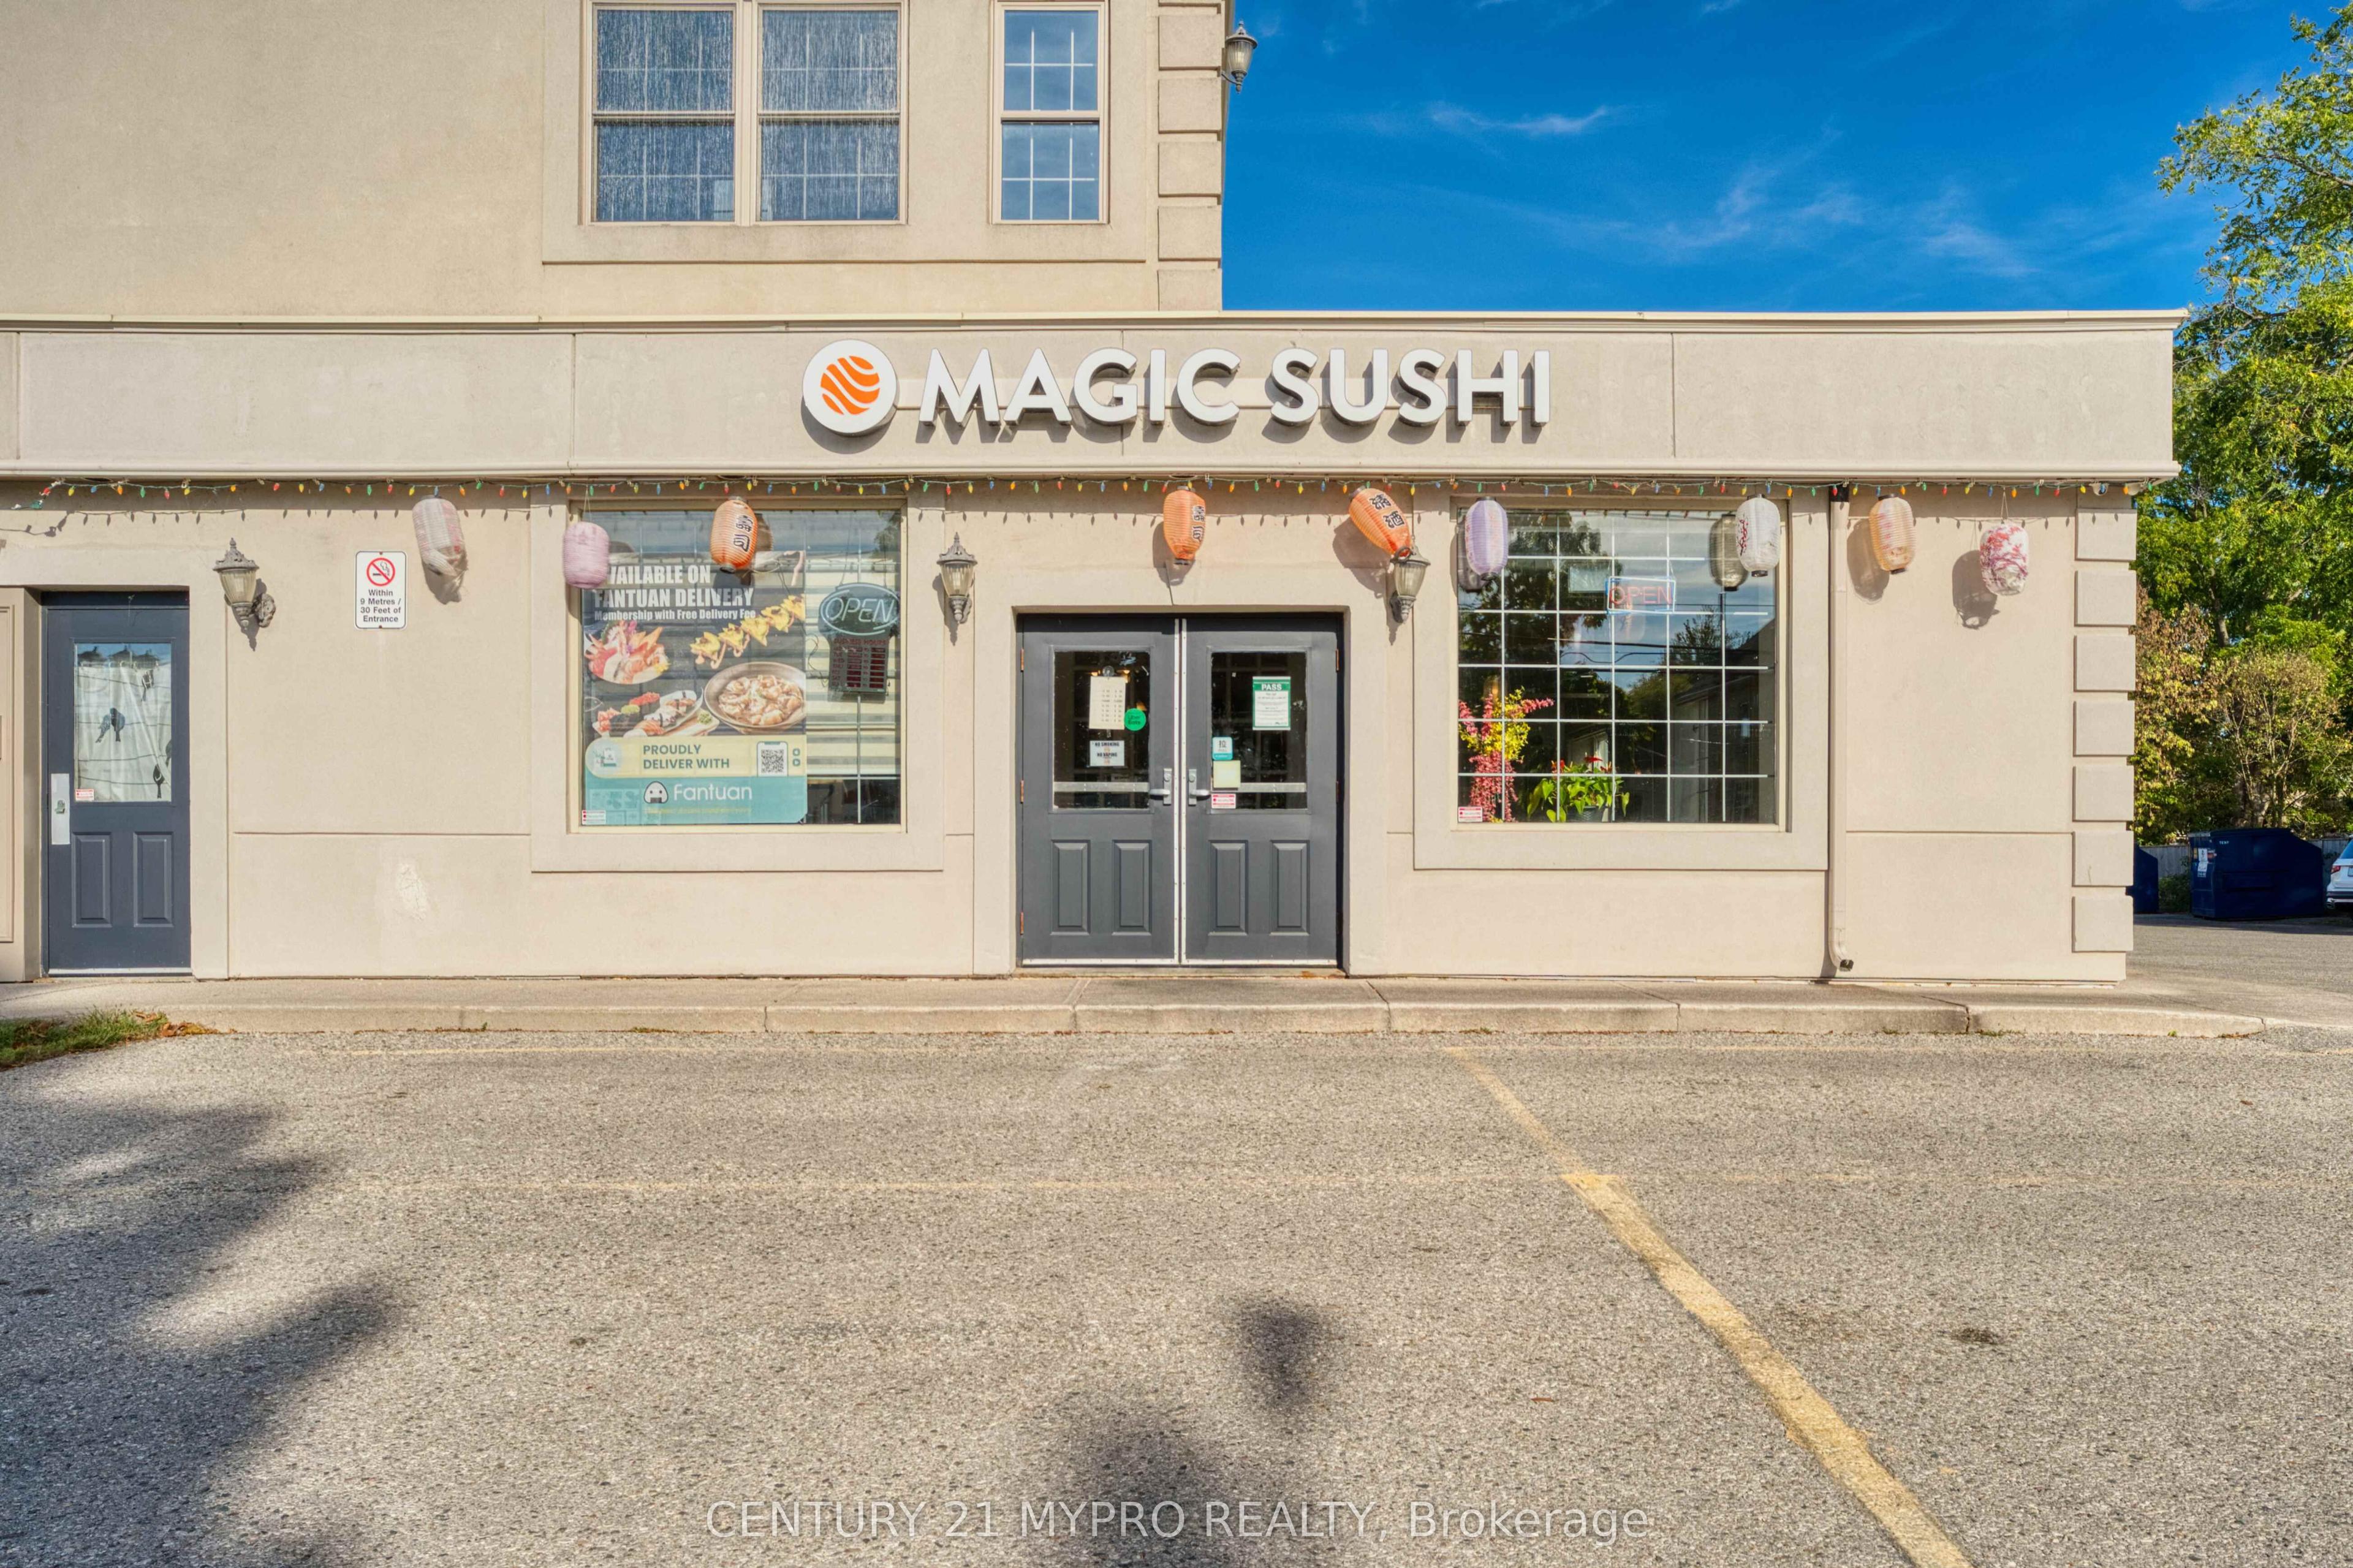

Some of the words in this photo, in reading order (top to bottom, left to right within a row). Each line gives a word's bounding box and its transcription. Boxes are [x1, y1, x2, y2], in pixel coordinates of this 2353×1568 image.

[918, 348, 1240, 427] MAGIC
[1270, 348, 1550, 427] SUSHI
[608, 566, 683, 584] VAILABLE
[688, 565, 710, 583] ON
[594, 589, 670, 608] FANTUAN
[675, 588, 754, 607] DELIVERY
[1609, 586, 1672, 604] OPEN
[594, 610, 652, 620] Membership
[654, 609, 675, 619] with
[677, 609, 697, 619] Free
[699, 608, 738, 621] Delivery
[740, 609, 756, 619] Fee
[825, 597, 894, 622] OPEN
[643, 744, 701, 755] PROUDLY
[643, 759, 693, 769] DELIVER
[697, 759, 730, 768] WITH
[674, 783, 752, 800] Fantuan
